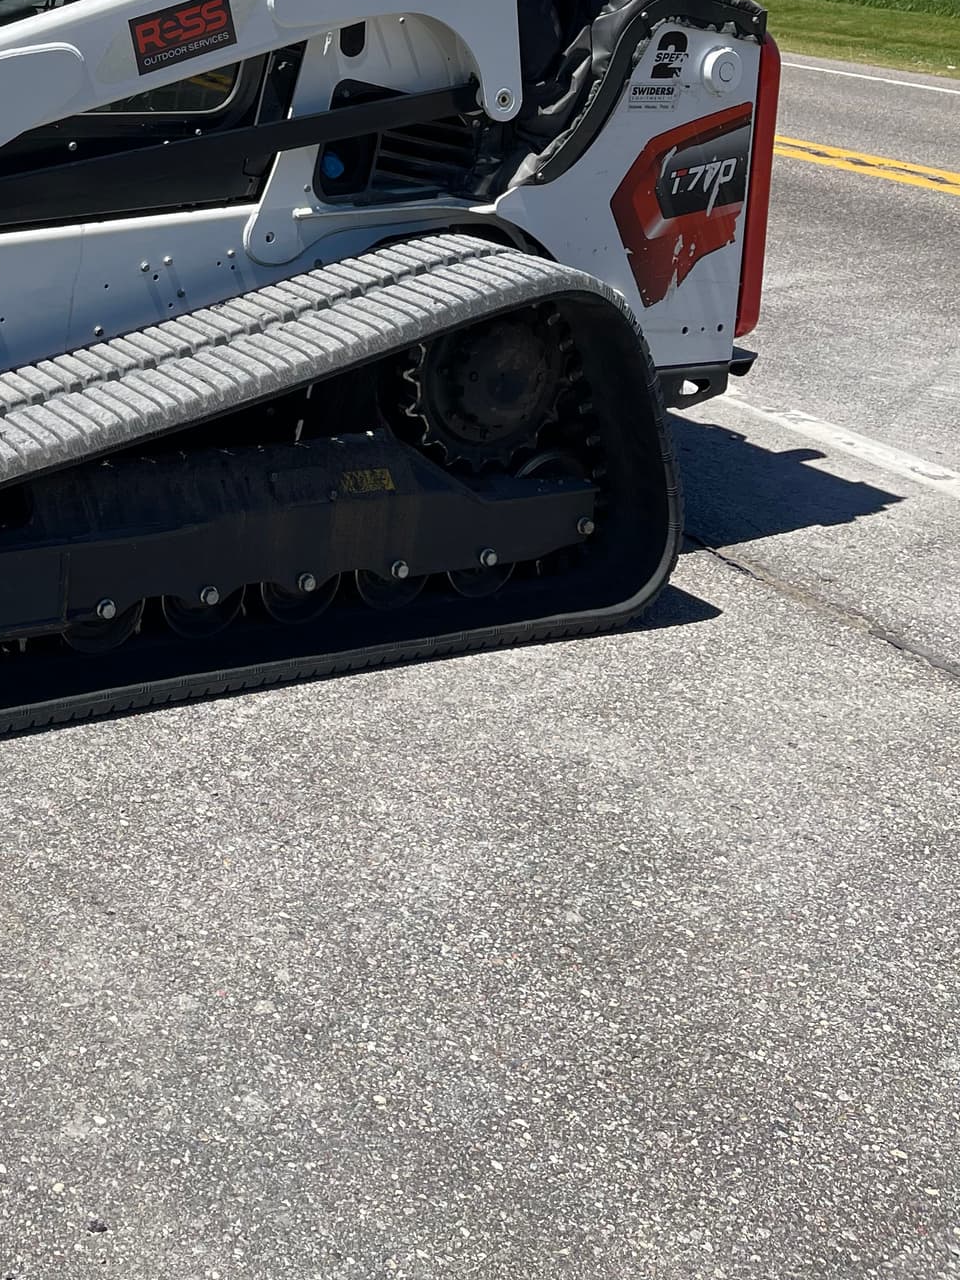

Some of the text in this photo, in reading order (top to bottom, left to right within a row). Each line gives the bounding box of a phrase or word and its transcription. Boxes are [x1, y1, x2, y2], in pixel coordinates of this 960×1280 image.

[143, 31, 230, 66] OUTDOOR SERVICES
[650, 30, 688, 79] 2
